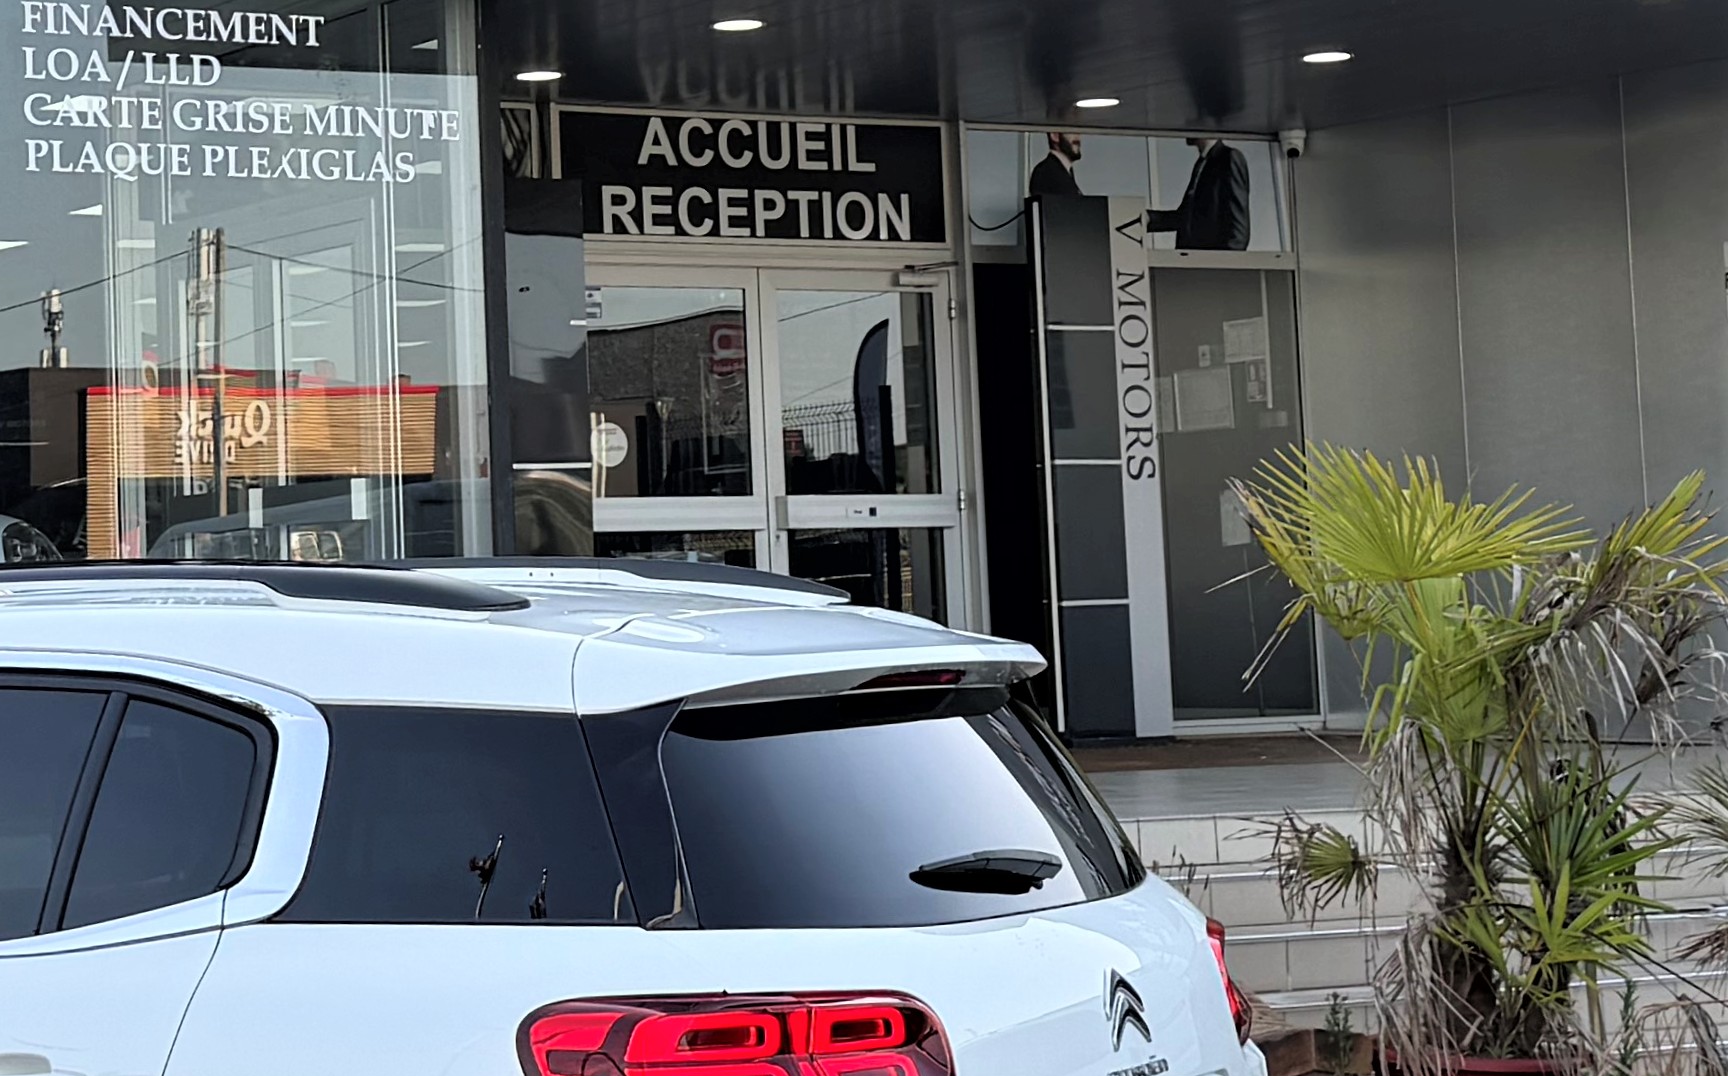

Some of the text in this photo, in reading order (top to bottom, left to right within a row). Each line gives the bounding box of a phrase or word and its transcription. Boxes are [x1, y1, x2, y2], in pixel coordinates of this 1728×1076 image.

[21, 1, 325, 47] FINANCEMENT
[22, 47, 222, 91] LOA/LLD
[23, 93, 461, 142] CARTE GRISE MINUTE
[24, 139, 416, 183] PLAQUE PLEXIGLAS
[637, 116, 877, 173] ACCUEIL
[601, 184, 912, 241] RECEPTION
[1115, 213, 1156, 481] V MOTORS
